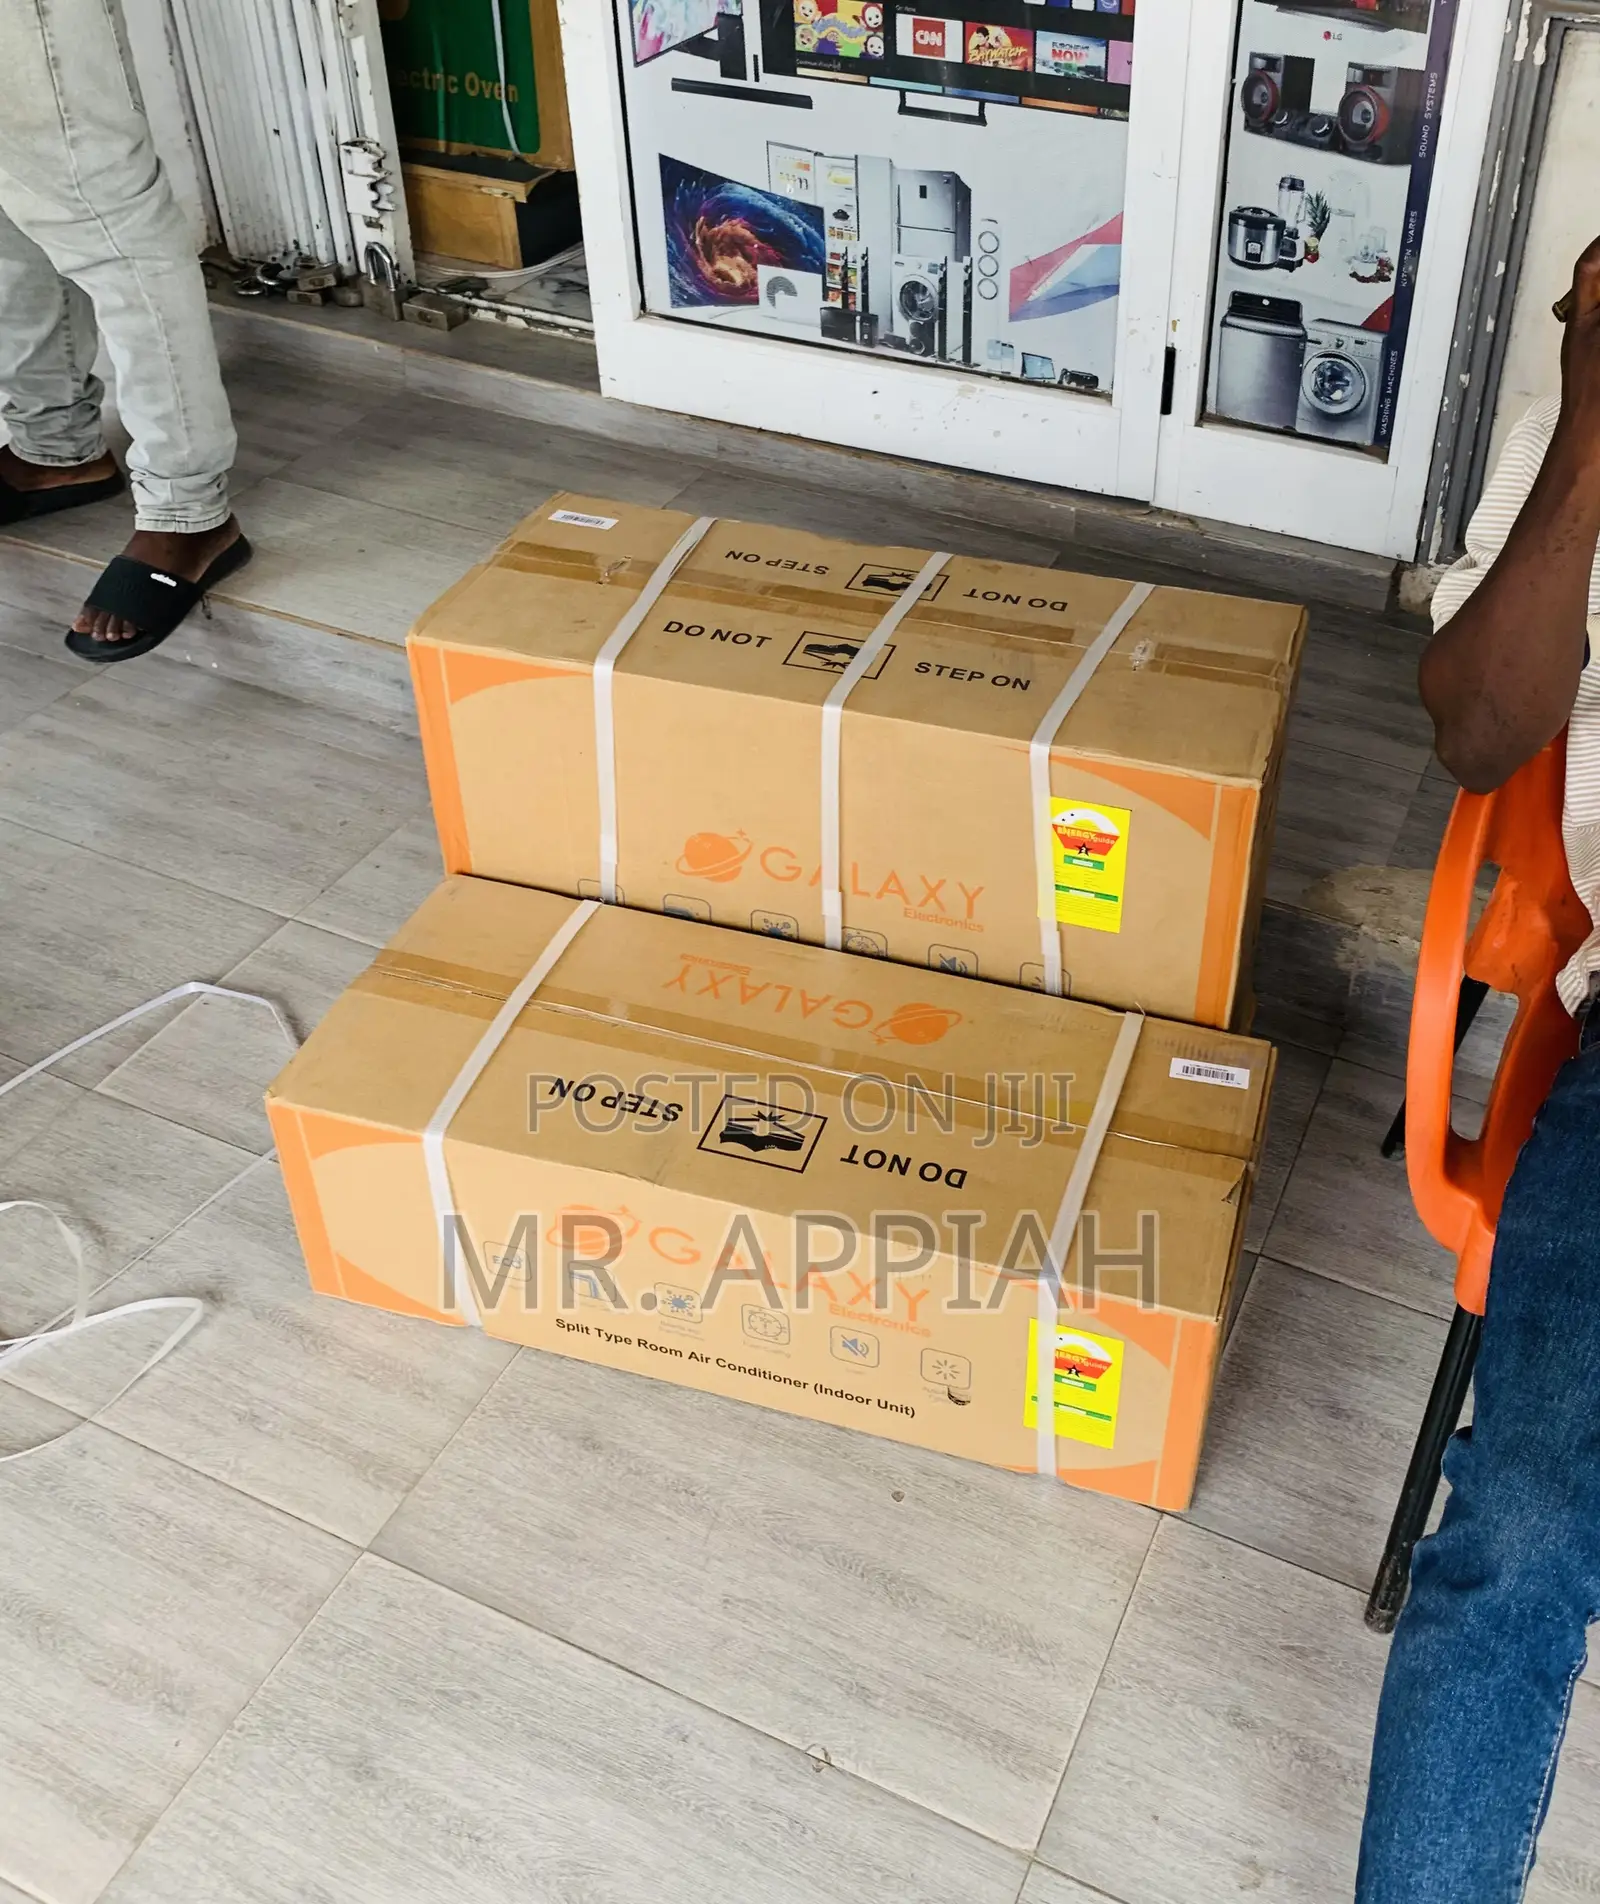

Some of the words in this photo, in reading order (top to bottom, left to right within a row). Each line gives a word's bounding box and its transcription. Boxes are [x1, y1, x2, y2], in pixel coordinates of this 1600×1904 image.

[915, 29, 943, 47] CNN
[1332, 32, 1343, 41] LG
[396, 67, 459, 94] ectric
[465, 71, 519, 102] Oven
[1424, 72, 1438, 119] SYSTEMS
[1418, 124, 1431, 158] SOUND
[1406, 210, 1418, 244] WARES
[725, 550, 760, 563] ON
[766, 560, 829, 576] STEP
[962, 588, 1021, 605] NOT
[1027, 598, 1068, 612] DO
[663, 621, 705, 637] DO
[710, 628, 772, 648] NOT
[914, 662, 984, 681] STEP
[990, 675, 1031, 691] ON
[760, 846, 985, 919] GLAXY
[903, 907, 985, 933] Electronics
[661, 964, 874, 1030] GALAXY
[548, 1077, 597, 1102] ON
[600, 1091, 684, 1122] STEP
[840, 1144, 912, 1176] NOT
[918, 1162, 968, 1190] DO
[648, 1226, 931, 1322] GALAXY
[828, 1303, 932, 1338] Electronics
[555, 1318, 591, 1336] Split
[594, 1327, 632, 1348] Type
[637, 1338, 683, 1358] Room
[688, 1351, 711, 1364] Air
[715, 1358, 809, 1390] Conditioner
[813, 1382, 872, 1406] (Indoor
[877, 1398, 916, 1419] Unit)
